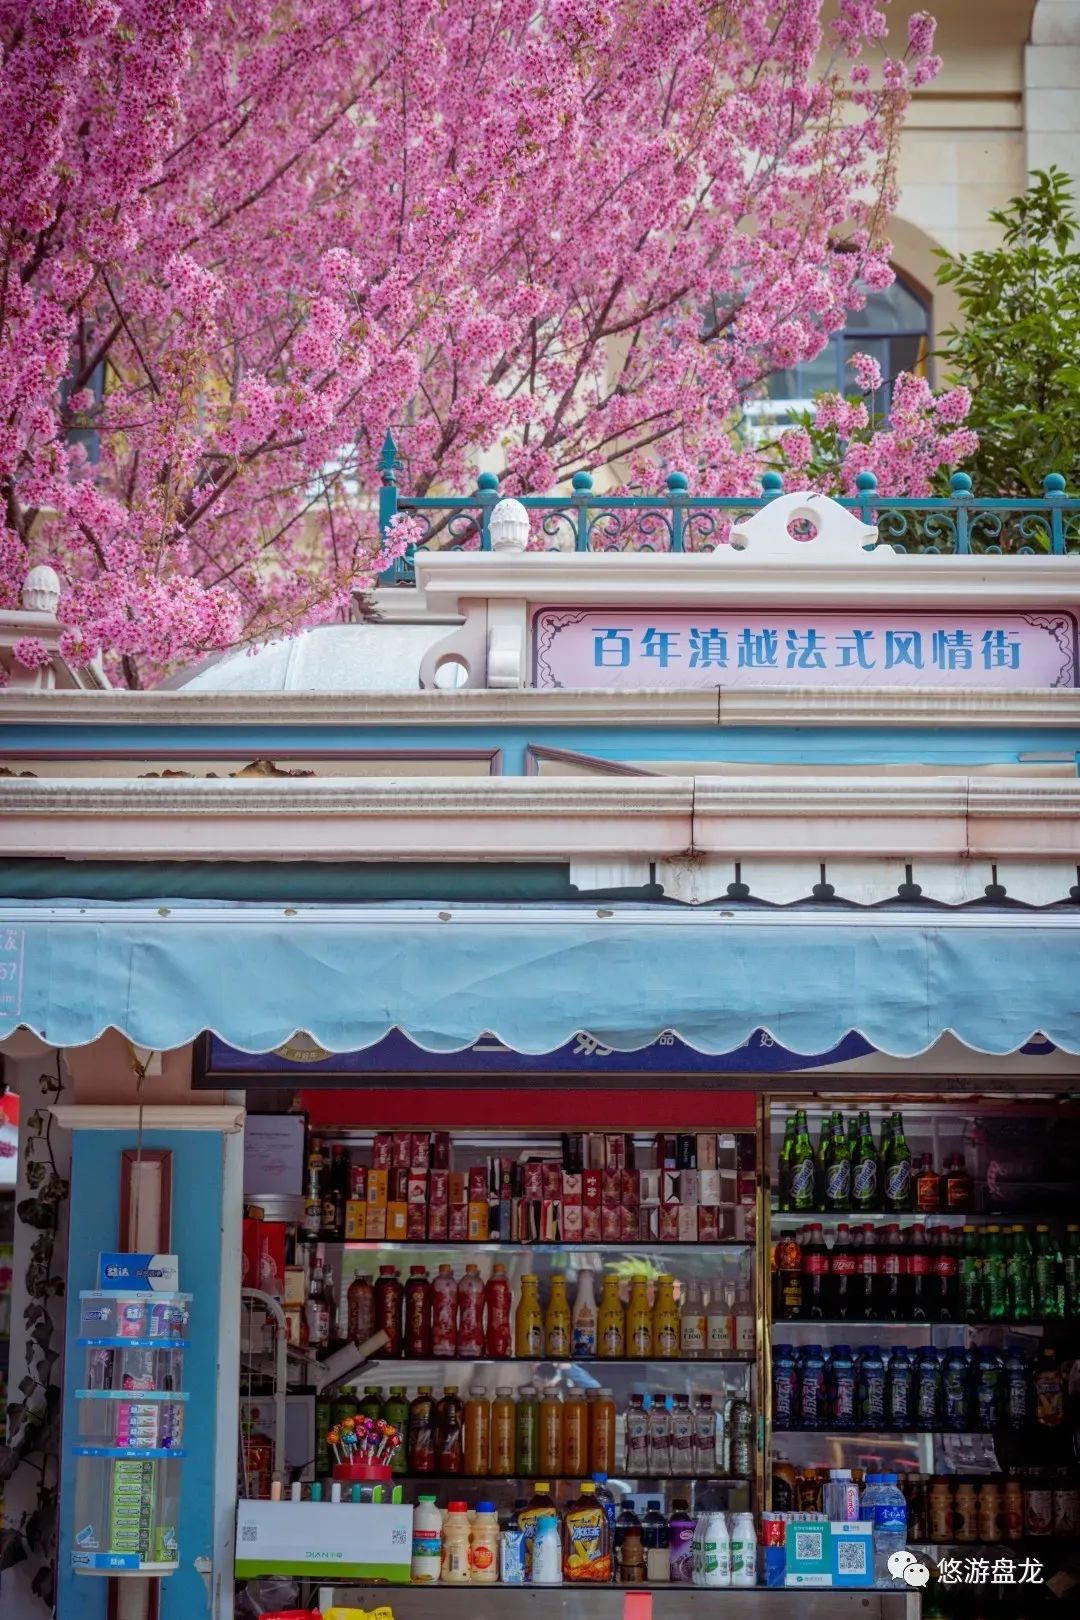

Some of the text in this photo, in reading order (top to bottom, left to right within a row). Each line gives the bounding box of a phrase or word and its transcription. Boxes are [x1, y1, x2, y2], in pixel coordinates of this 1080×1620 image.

[591, 628, 1022, 670] 百年滇越法式风情街
